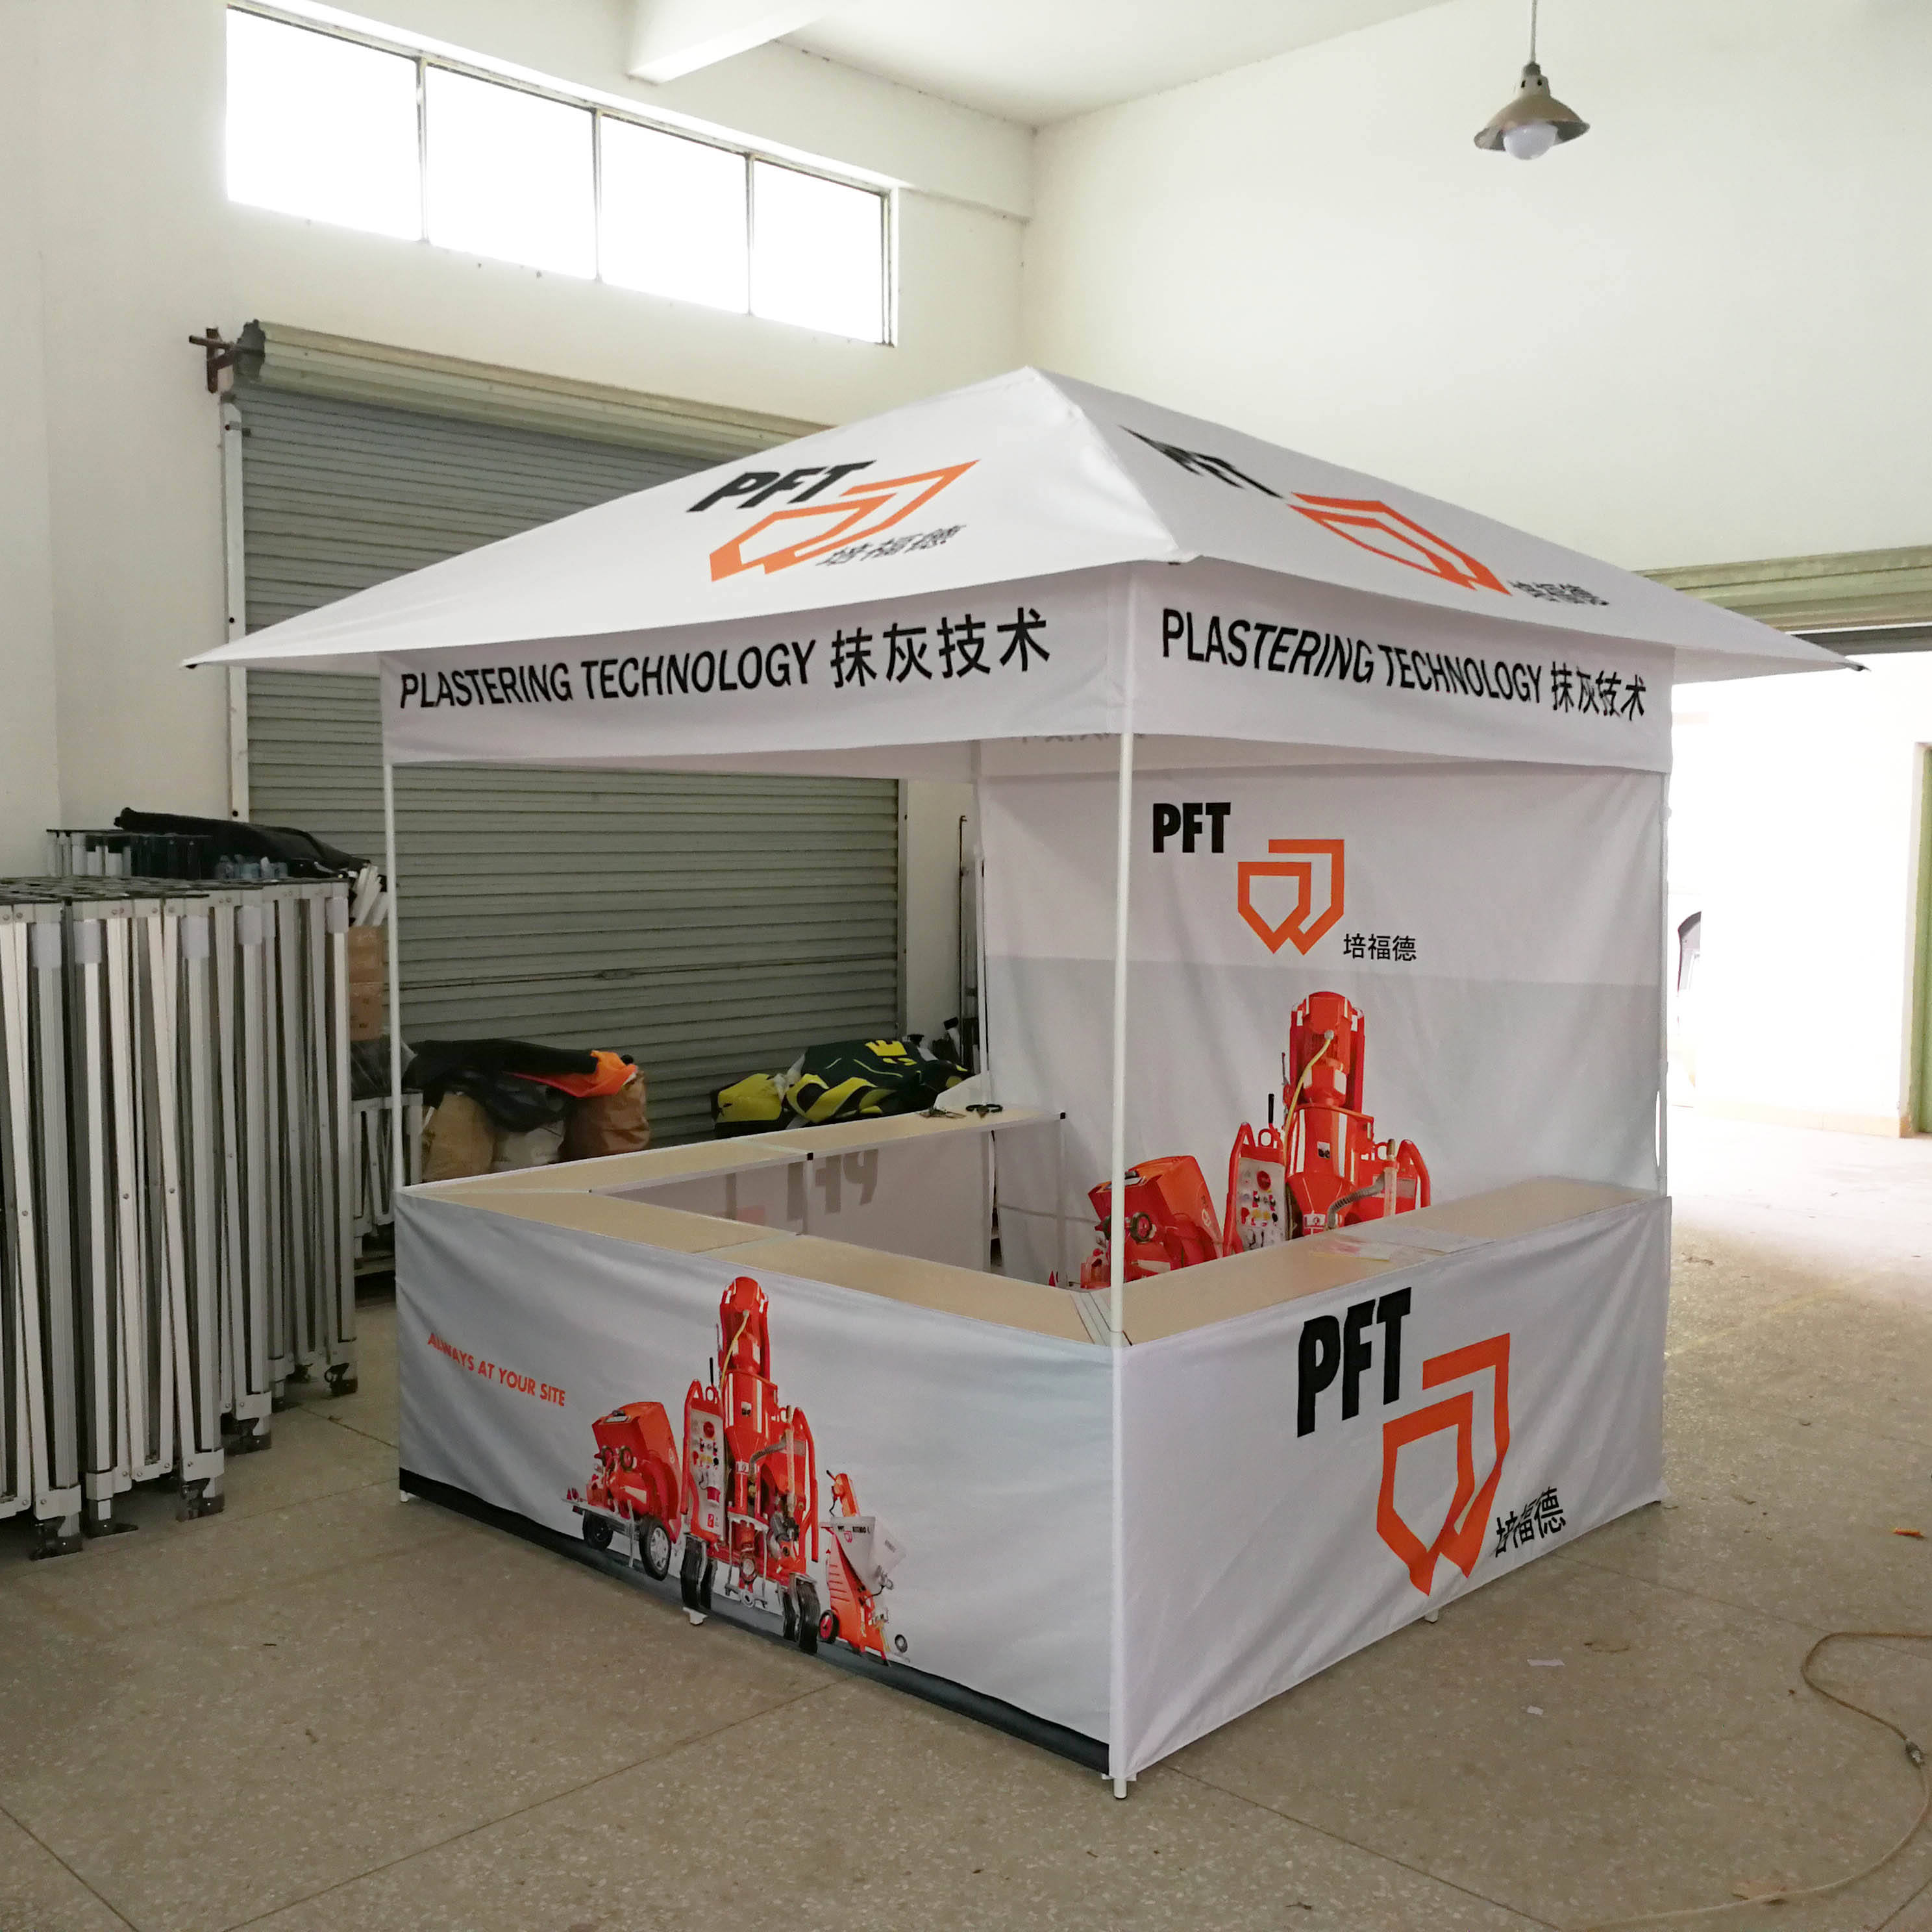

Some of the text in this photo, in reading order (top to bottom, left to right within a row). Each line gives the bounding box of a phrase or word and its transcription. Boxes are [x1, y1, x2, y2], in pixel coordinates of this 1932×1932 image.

[686, 460, 877, 513] PFT
[400, 607, 1050, 709] PLASTERING TECHNOLOGY 抹灰技术
[1163, 608, 1646, 721] PLASTERING TECHNOLOGY 抹灰技术
[1153, 802, 1231, 853] PFT
[1343, 933, 1417, 961] 培福德
[427, 1333, 565, 1407] ALWAYS AT YOUR SITE
[1297, 1287, 1411, 1438] PFT
[1495, 1486, 1567, 1558] 培福德
